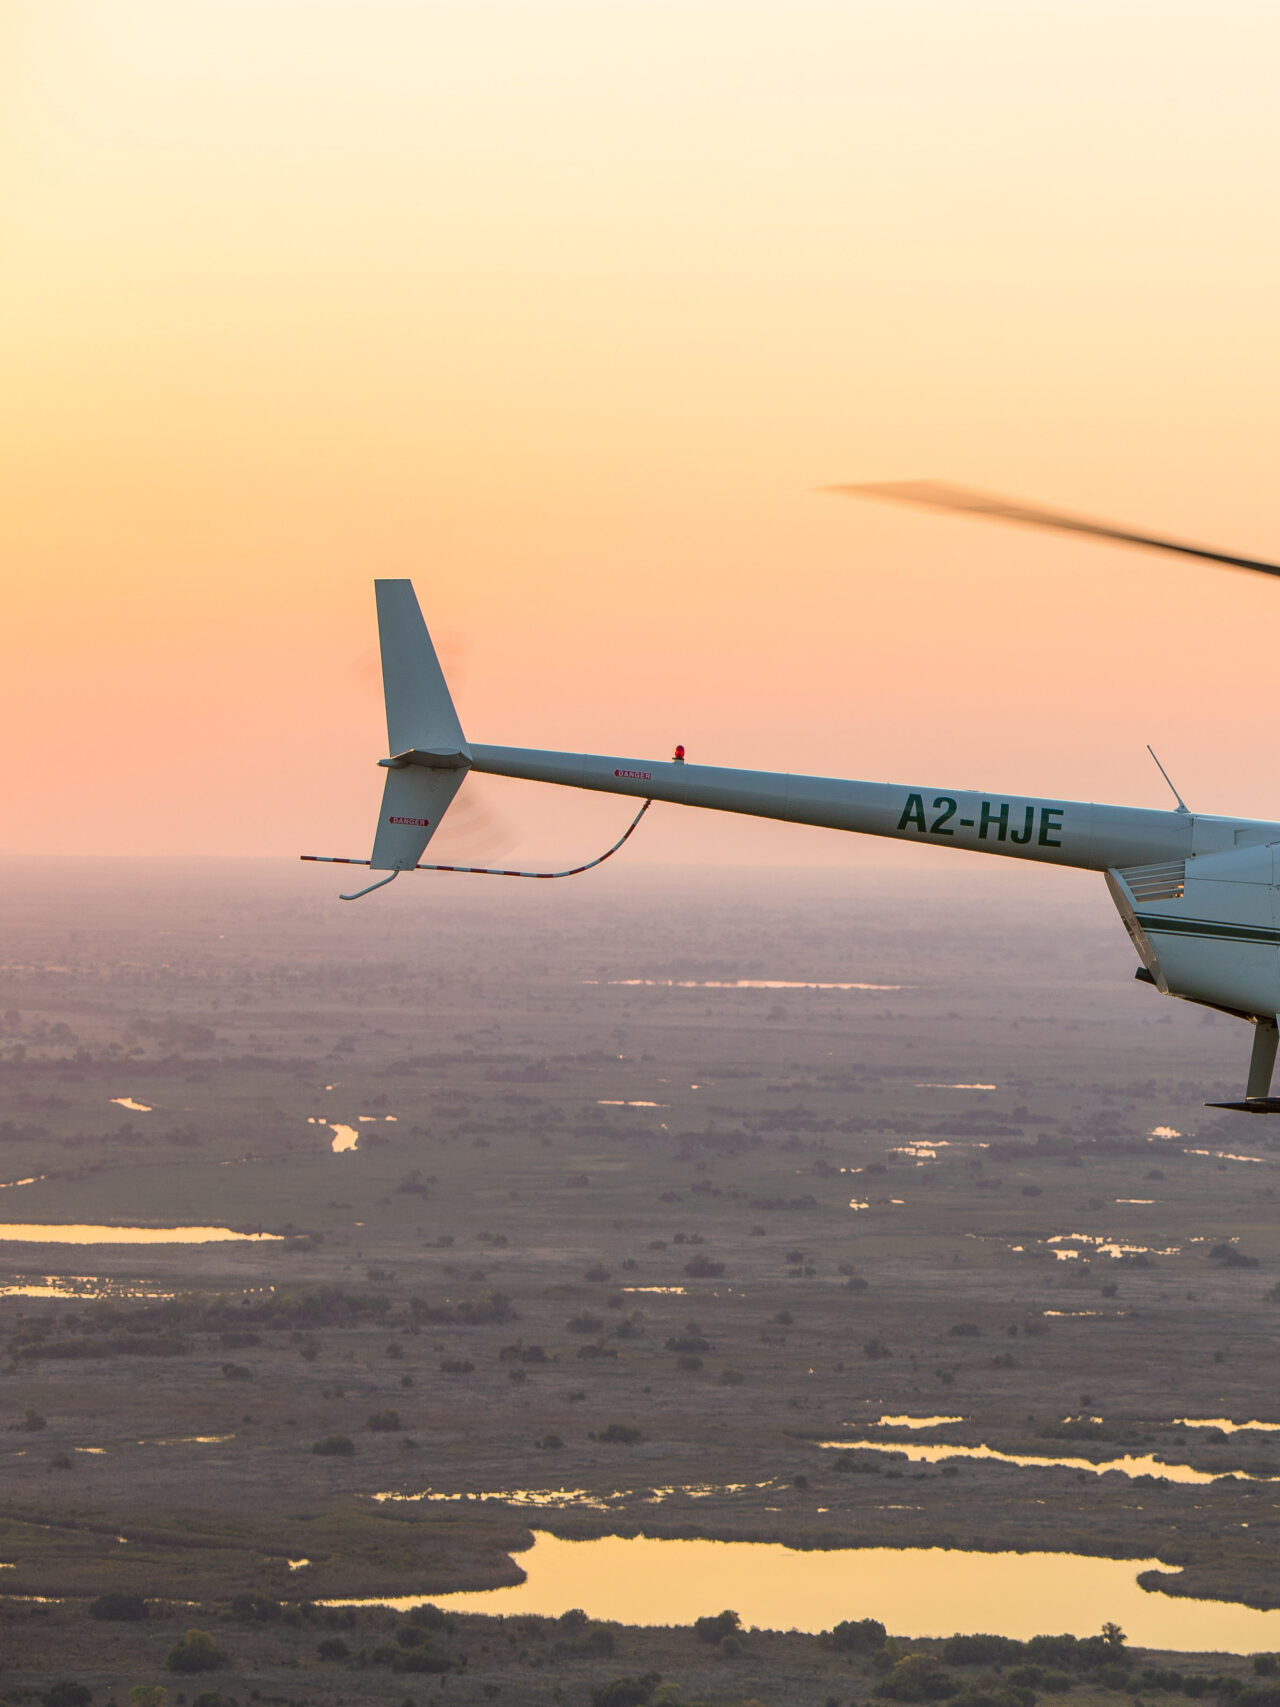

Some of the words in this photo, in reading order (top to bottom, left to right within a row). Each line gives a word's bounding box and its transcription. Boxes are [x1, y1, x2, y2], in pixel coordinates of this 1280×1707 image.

[618, 770, 651, 780] DANGER
[393, 817, 425, 826] DANGER
[897, 793, 1064, 848] A2-HJE
